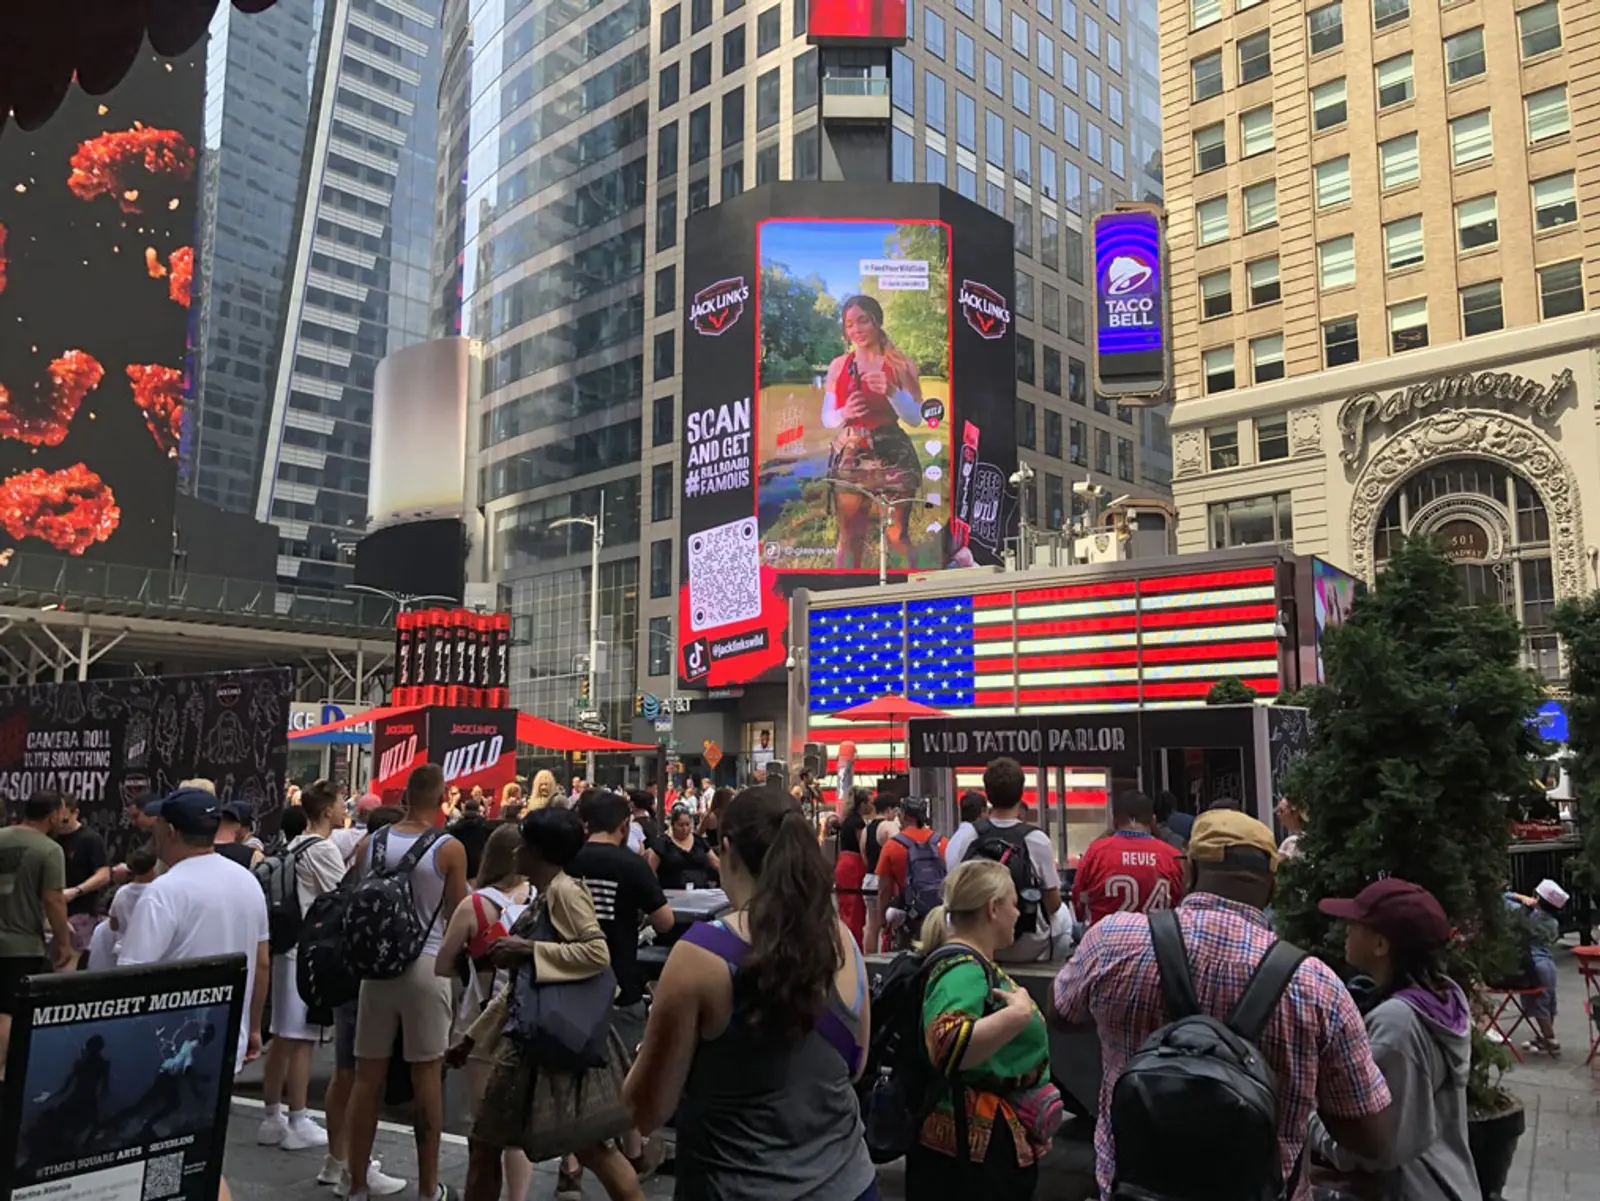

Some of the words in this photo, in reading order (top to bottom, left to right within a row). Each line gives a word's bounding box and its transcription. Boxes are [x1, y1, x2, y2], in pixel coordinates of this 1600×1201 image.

[689, 298, 716, 320] JACK
[716, 285, 749, 309] LINK'S
[958, 288, 983, 312] JACK
[983, 298, 1010, 323] LINK'S
[1105, 298, 1153, 313] TACO
[1109, 312, 1154, 327] BELL
[687, 398, 750, 444] SCAN
[1337, 367, 1573, 464] Paramount
[687, 440, 720, 468] AND
[722, 432, 751, 458] GET
[701, 469, 750, 496] FAMOUS
[288, 711, 315, 732] ICE
[27, 730, 80, 749] CAMERA
[83, 729, 111, 748] ROLL
[922, 732, 968, 753] WILD
[973, 730, 1042, 752] TATTOO
[1049, 727, 1125, 751] PARLOR
[24, 751, 50, 767] WITH
[51, 750, 111, 768] SOMETHING
[379, 734, 418, 783] WILD
[443, 735, 503, 782] WILD
[1122, 852, 1156, 866] REVIS
[1105, 874, 1171, 914] 24
[32, 996, 146, 1026] MIDNIGHT
[148, 985, 234, 1011] MOMENT
[77, 1152, 115, 1169] SQUARE
[116, 1146, 143, 1160] ARTS
